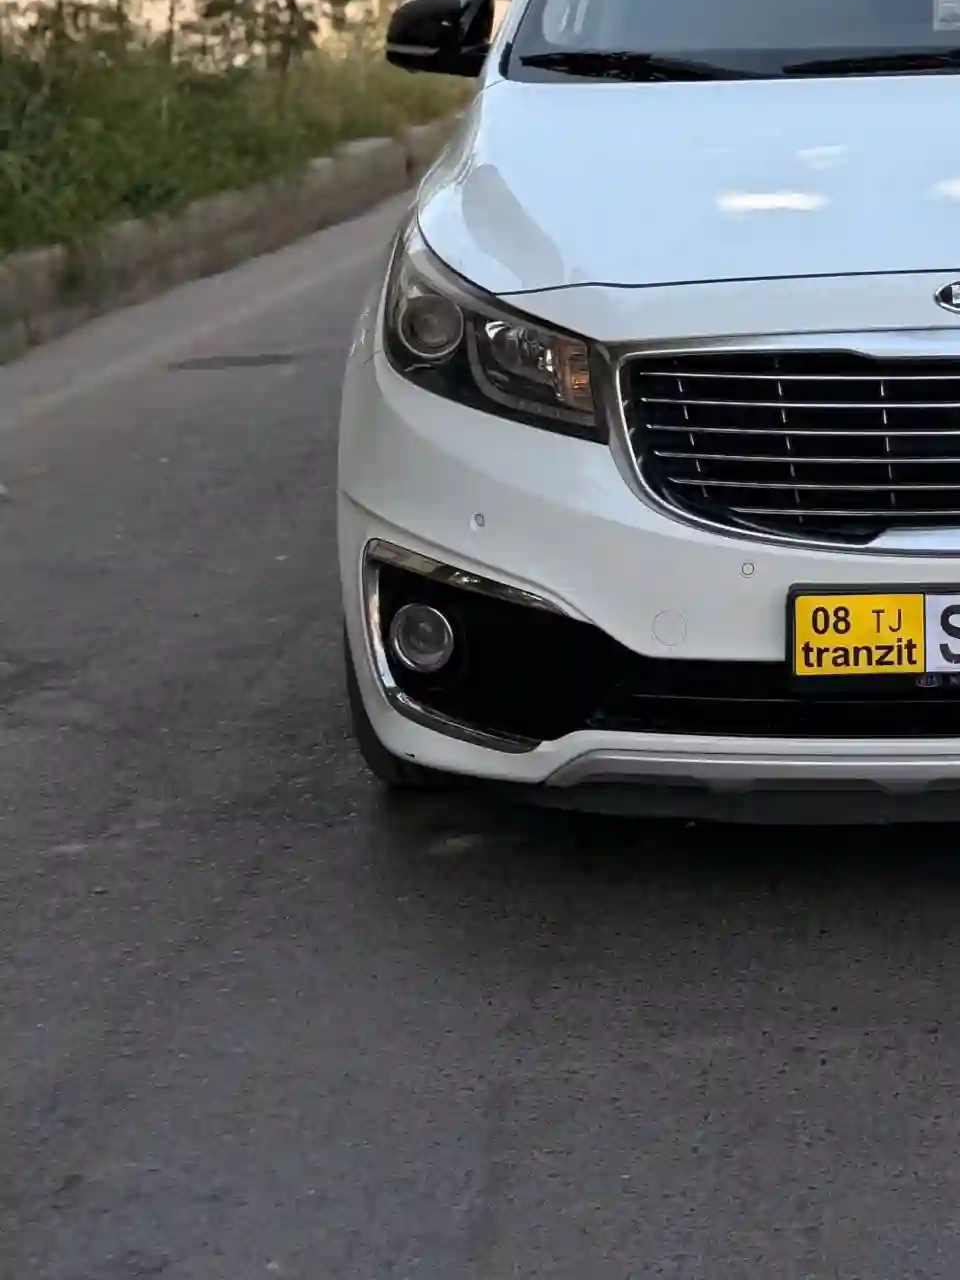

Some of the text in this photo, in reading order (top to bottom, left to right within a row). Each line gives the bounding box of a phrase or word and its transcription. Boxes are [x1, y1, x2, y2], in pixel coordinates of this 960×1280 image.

[811, 606, 903, 634] 08 TJ
[801, 638, 918, 667] tranzit
